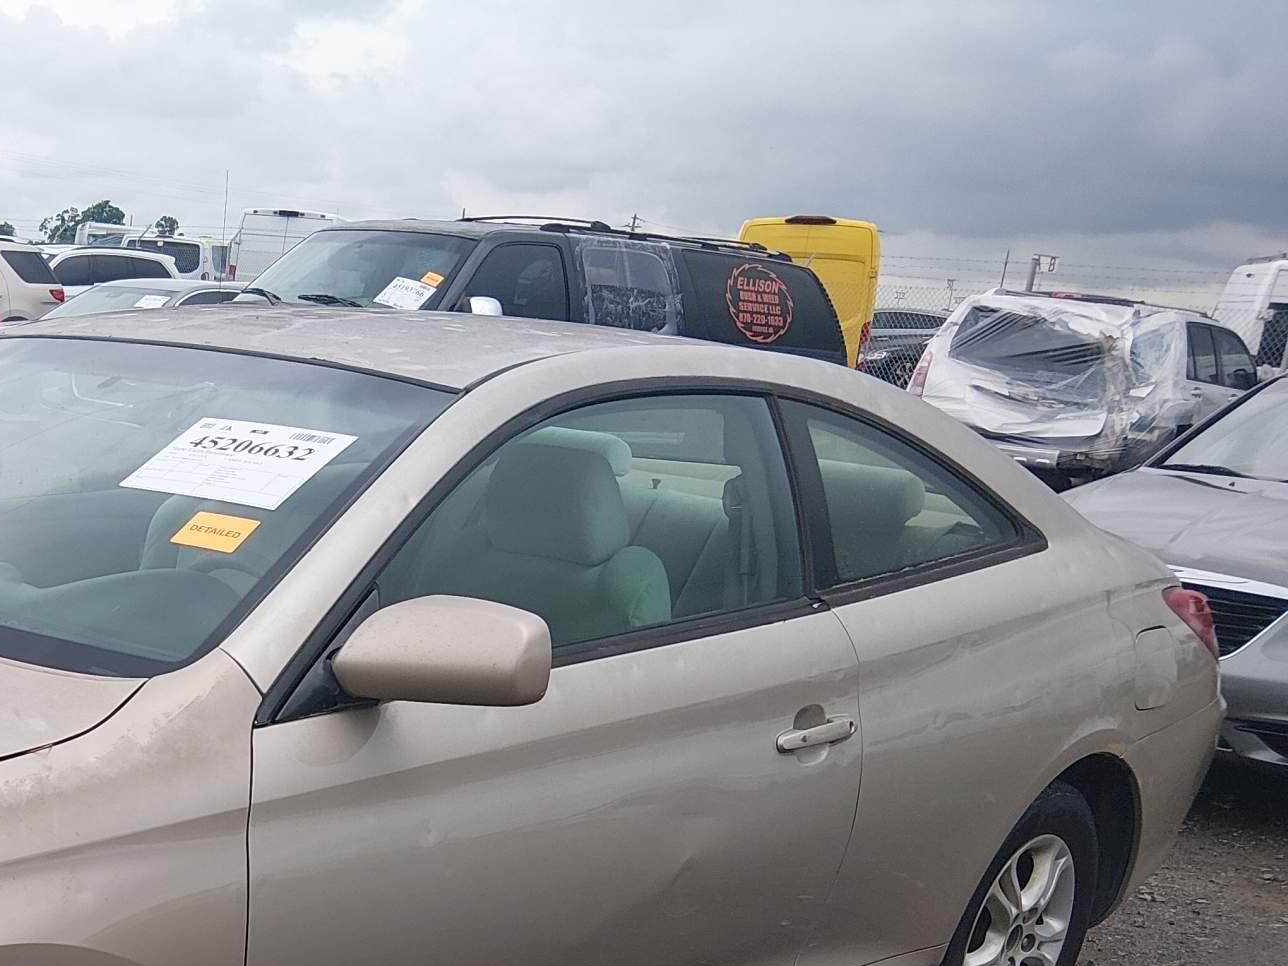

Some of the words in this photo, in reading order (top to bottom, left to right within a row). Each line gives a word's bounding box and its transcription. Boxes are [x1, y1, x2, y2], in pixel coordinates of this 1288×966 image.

[737, 276, 780, 294] ELLISON
[739, 303, 769, 313] SERVICE
[769, 306, 781, 315] LLC
[189, 435, 316, 461] 45206632
[189, 524, 241, 539] DETAILED
